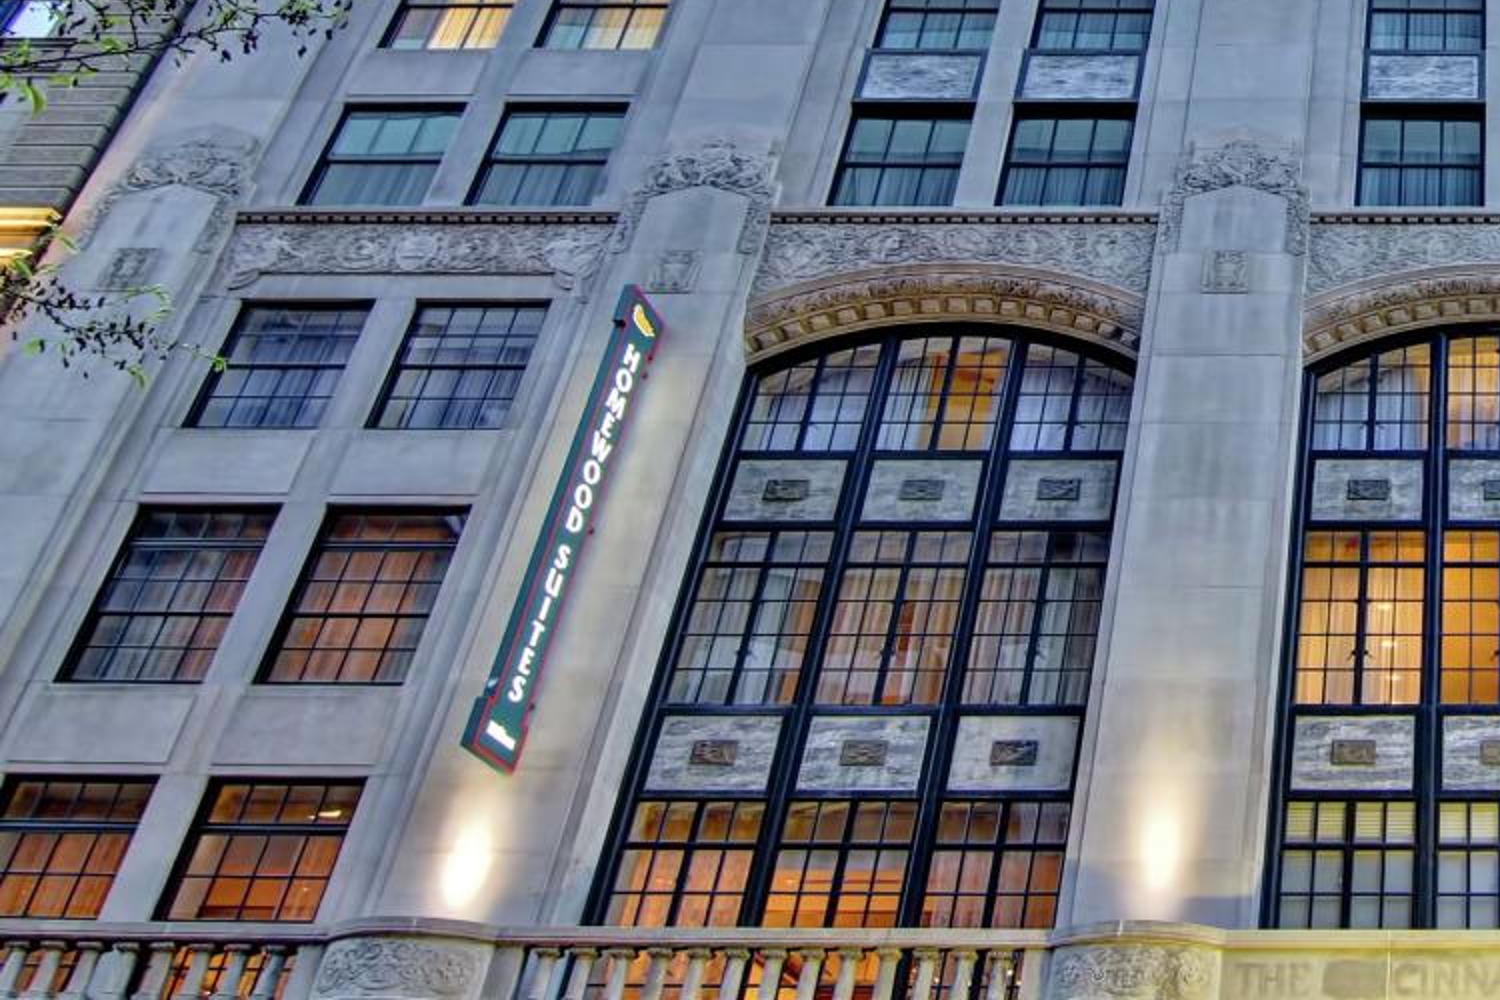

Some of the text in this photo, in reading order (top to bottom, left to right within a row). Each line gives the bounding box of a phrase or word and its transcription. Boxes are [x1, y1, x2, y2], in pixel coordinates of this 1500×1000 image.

[507, 343, 641, 702] HOMEWOOD SUITES
[1234, 961, 1314, 997] THE
